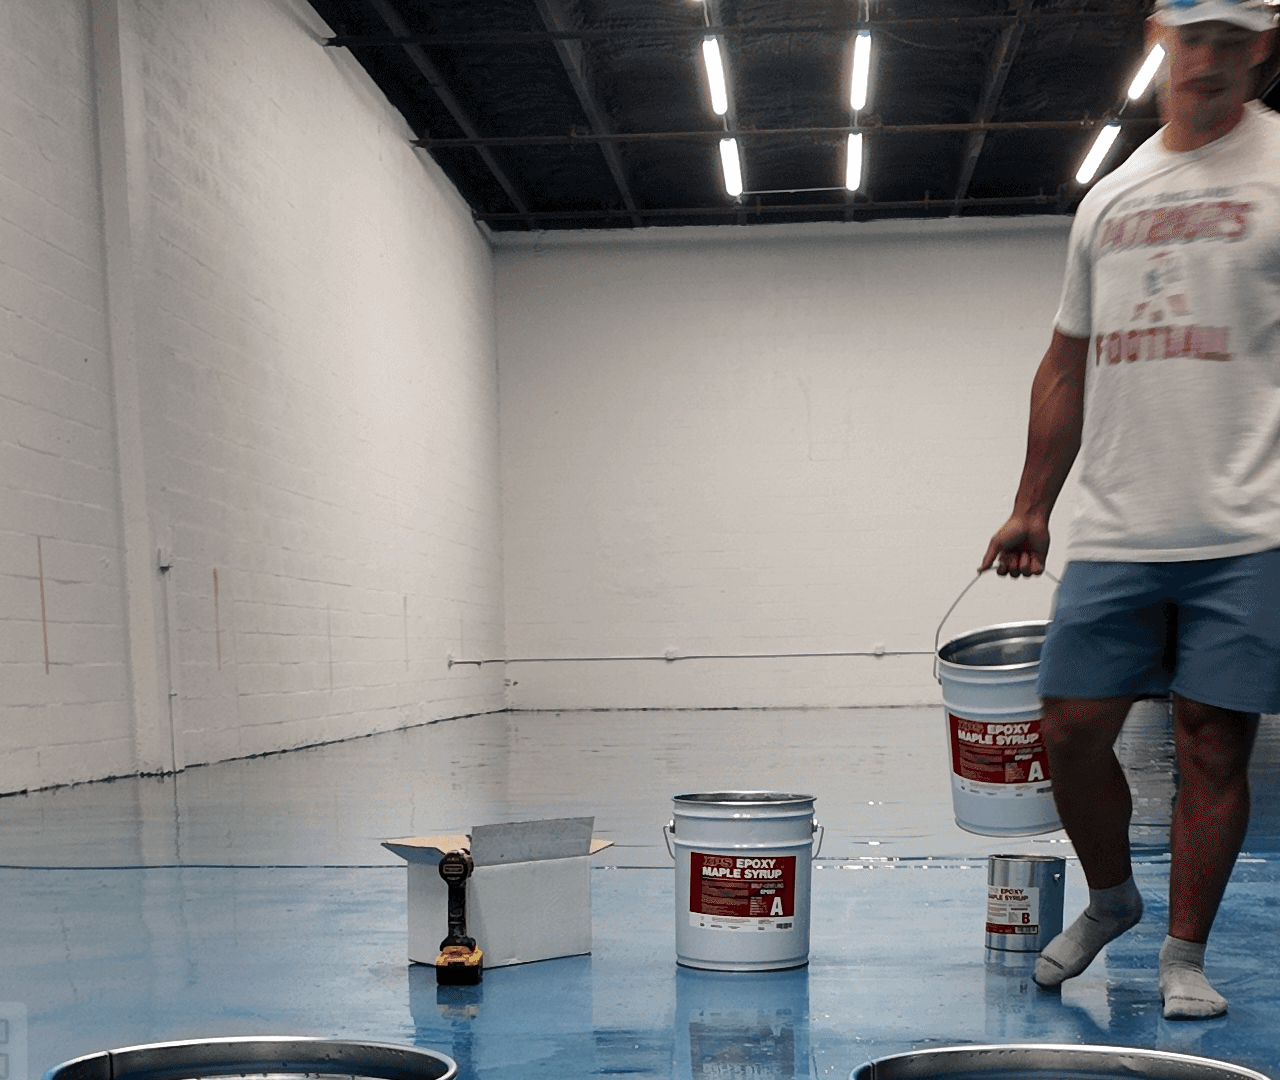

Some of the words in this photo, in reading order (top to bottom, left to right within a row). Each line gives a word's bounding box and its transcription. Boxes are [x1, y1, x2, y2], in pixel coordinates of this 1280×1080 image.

[987, 723, 1031, 735] EPOXY
[958, 730, 993, 744] MAPLE
[996, 732, 1039, 745] SYRUP
[1028, 761, 1044, 781] A
[736, 859, 776, 868] EPOXY
[702, 866, 741, 878] MAPLE
[744, 869, 782, 878] SYRUP
[770, 896, 783, 916] A
[1022, 912, 1030, 924] B
